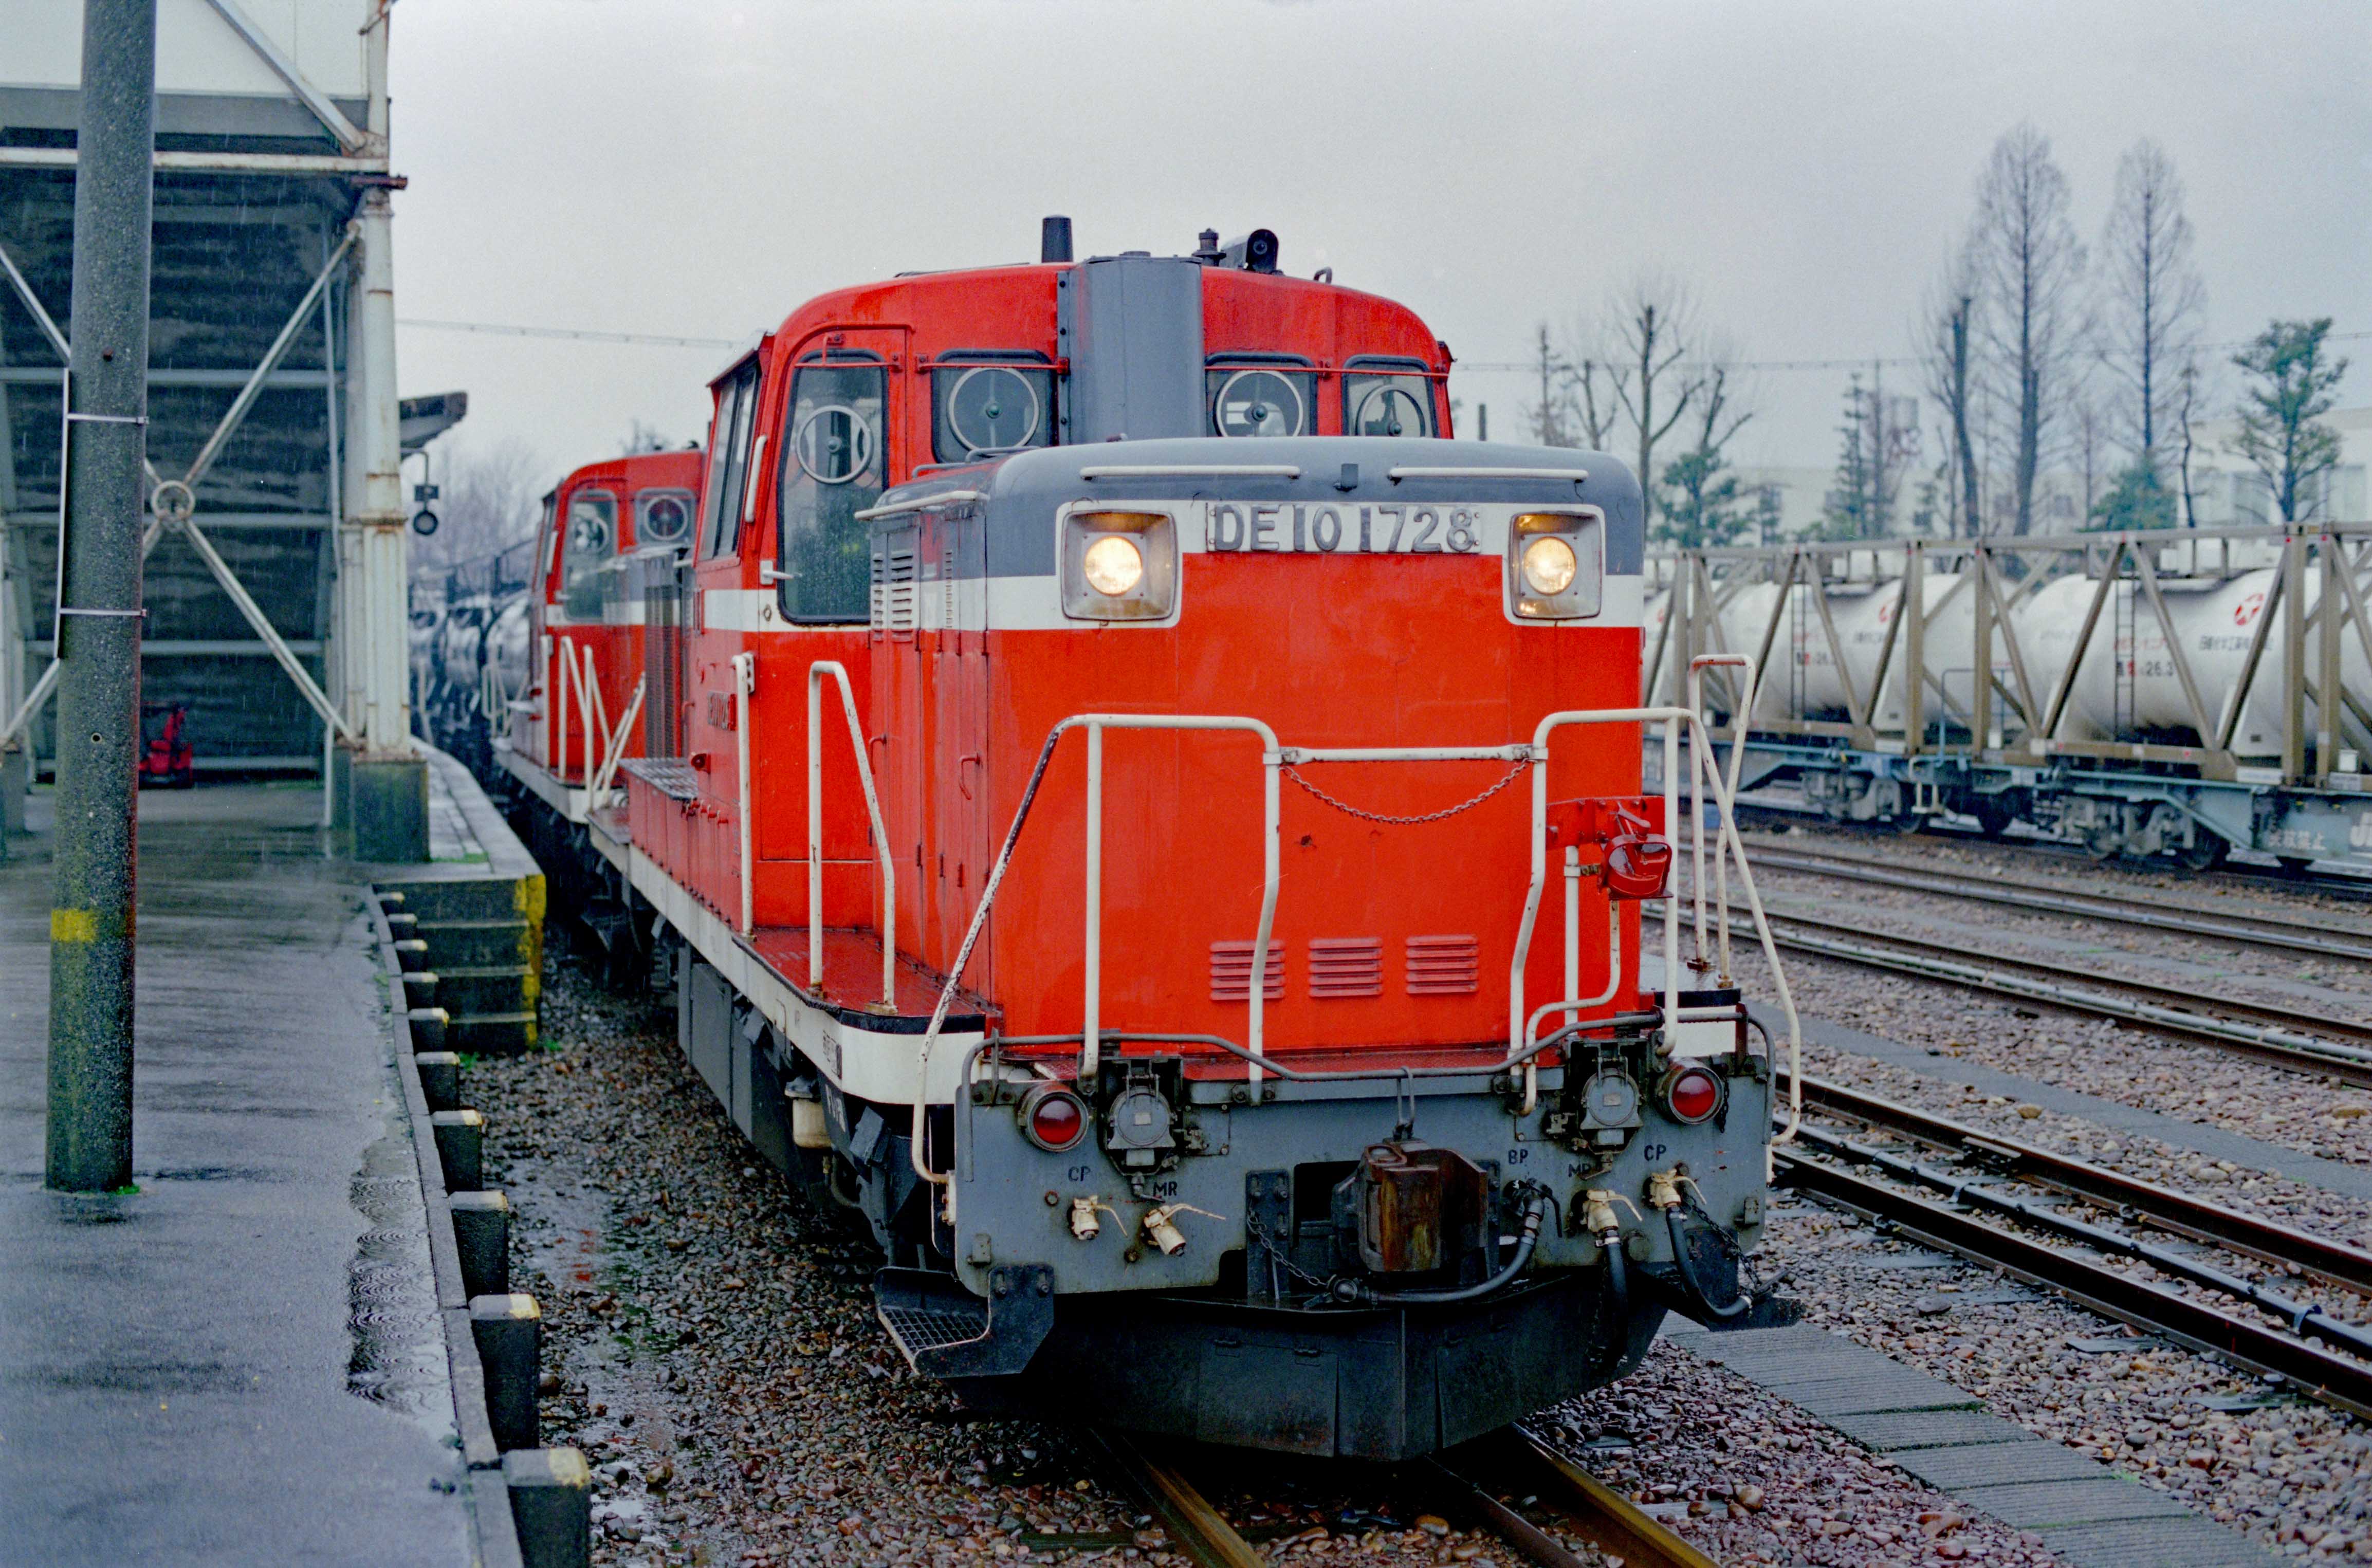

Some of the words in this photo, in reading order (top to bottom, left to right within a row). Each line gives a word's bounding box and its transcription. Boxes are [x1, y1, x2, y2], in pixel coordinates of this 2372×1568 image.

[1358, 504, 1476, 552] 1728
[1507, 1149, 1529, 1165] BP
[1644, 1144, 1667, 1161] CP
[1068, 1166, 1091, 1182] CP
[1152, 1180, 1178, 1196] MR
